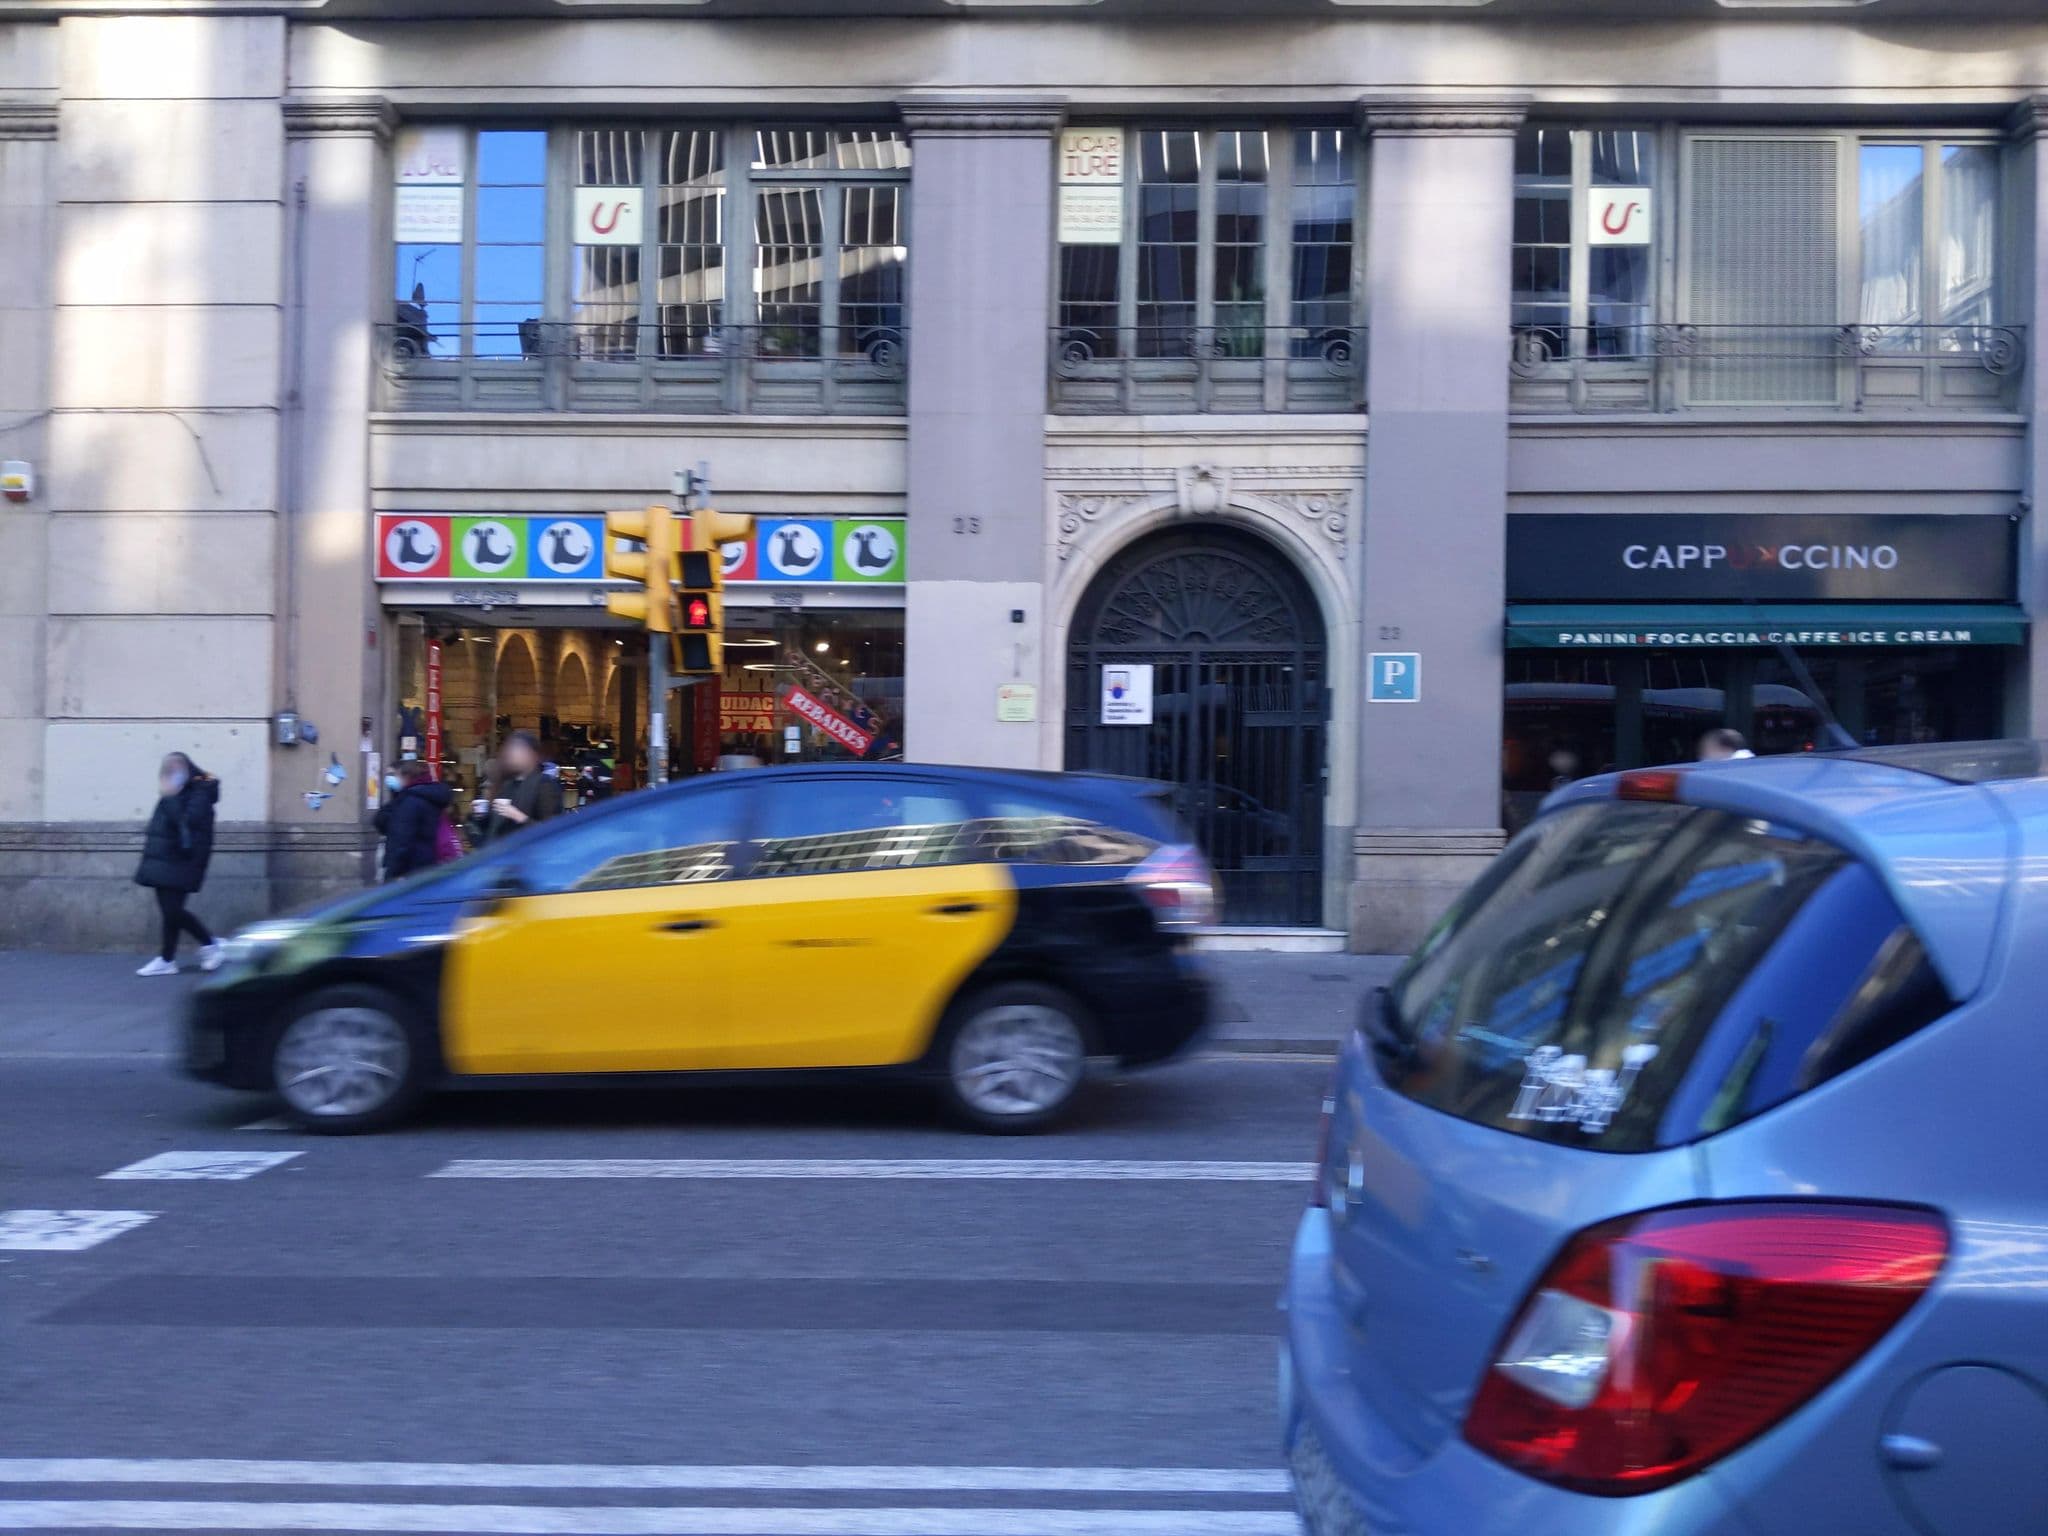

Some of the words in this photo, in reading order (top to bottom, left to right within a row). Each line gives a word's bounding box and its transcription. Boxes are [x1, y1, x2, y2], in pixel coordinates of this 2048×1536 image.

[1559, 632, 1637, 644] PANINI
[1645, 632, 1761, 644] FOCACCIA
[1767, 631, 1841, 643] CAFFE
[1848, 631, 1888, 643] ICE
[1894, 630, 1971, 642] CREAM
[1383, 660, 1406, 685] P
